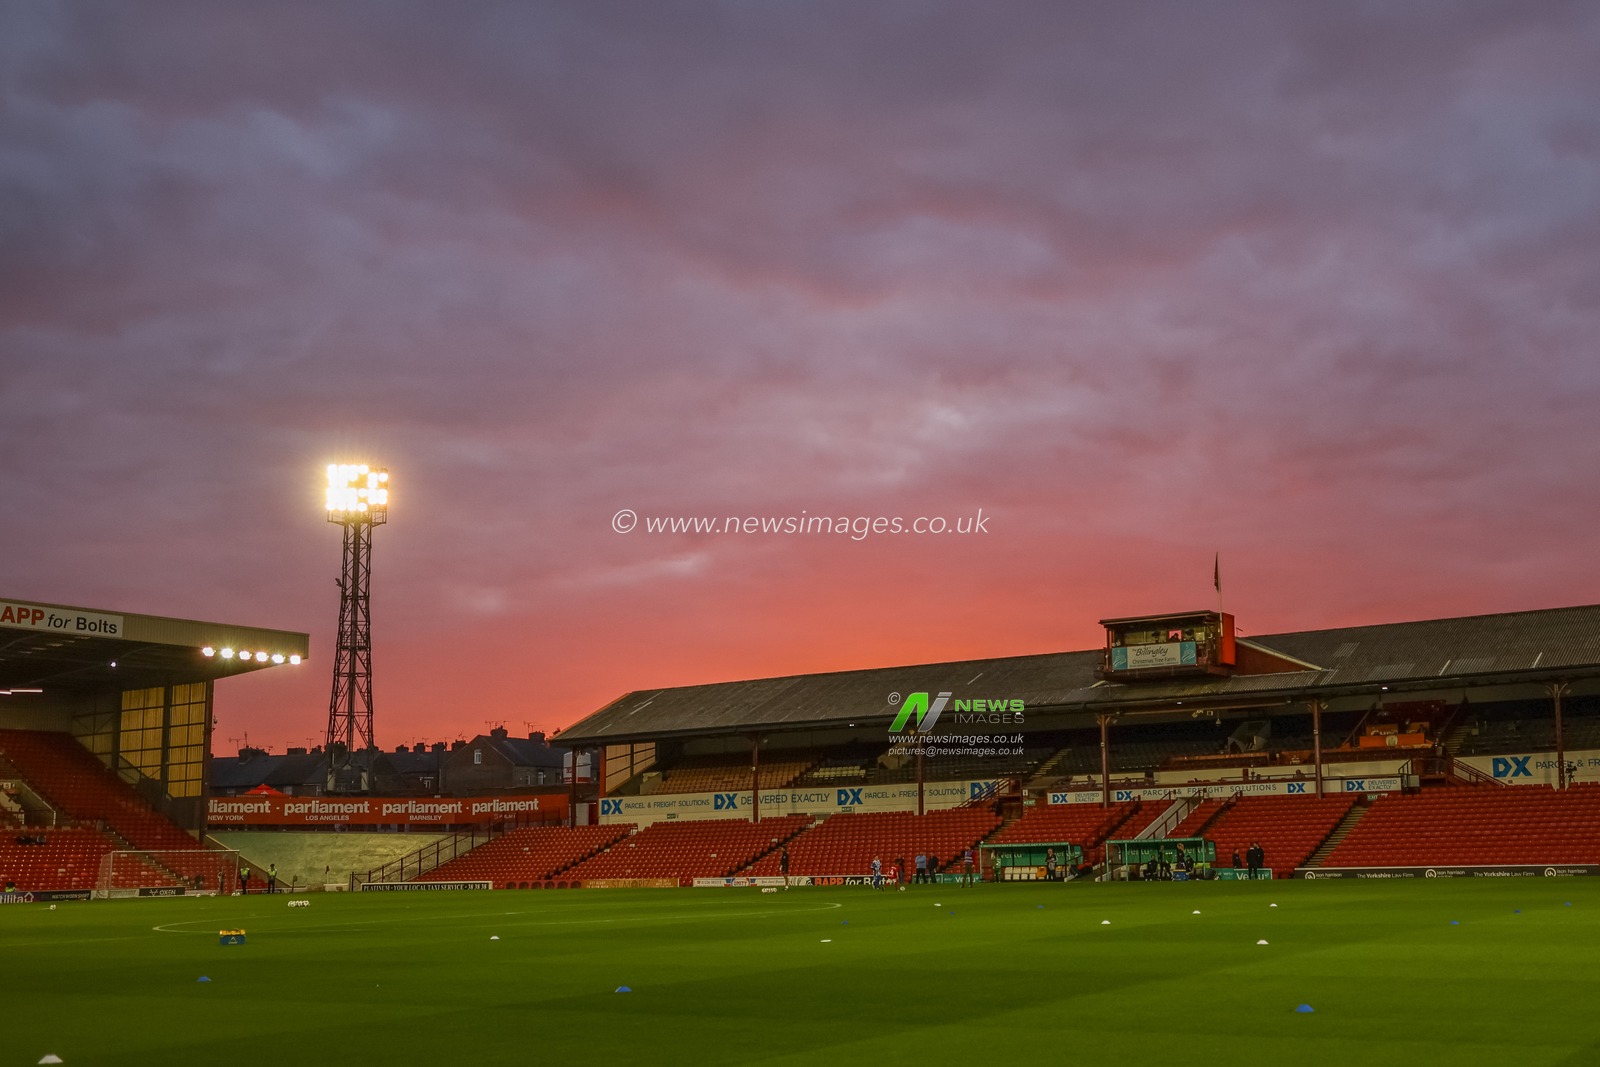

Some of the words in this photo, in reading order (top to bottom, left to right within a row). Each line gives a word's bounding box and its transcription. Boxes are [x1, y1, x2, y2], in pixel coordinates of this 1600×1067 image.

[47, 613, 72, 630] for
[76, 616, 118, 635] Bolts
[1492, 756, 1533, 778] DX
[1576, 759, 1584, 768] &
[1116, 790, 1133, 801] DX
[1187, 786, 1224, 794] FREGHT
[1229, 783, 1277, 793] SOLUTIONS
[1287, 782, 1306, 794] DX
[1346, 780, 1365, 792] DX
[713, 793, 738, 810] DX
[740, 794, 788, 806] DEVERED
[791, 792, 831, 804] EXACTLY
[837, 788, 864, 806] DX
[864, 790, 889, 799] PARCEL
[898, 789, 927, 798] FREIGT
[928, 787, 967, 797] SOLUTIONS
[1052, 793, 1068, 804] DX
[208, 799, 271, 813] liament
[284, 800, 370, 816] parliament
[382, 800, 463, 816] parliament
[472, 798, 539, 815] parliament
[601, 799, 623, 815] DX
[624, 802, 646, 810] PARCEL
[653, 800, 676, 808] FREIGHT
[678, 798, 710, 808] SOLUTIONS
[845, 877, 862, 886] for
[1236, 872, 1264, 881] Veu
